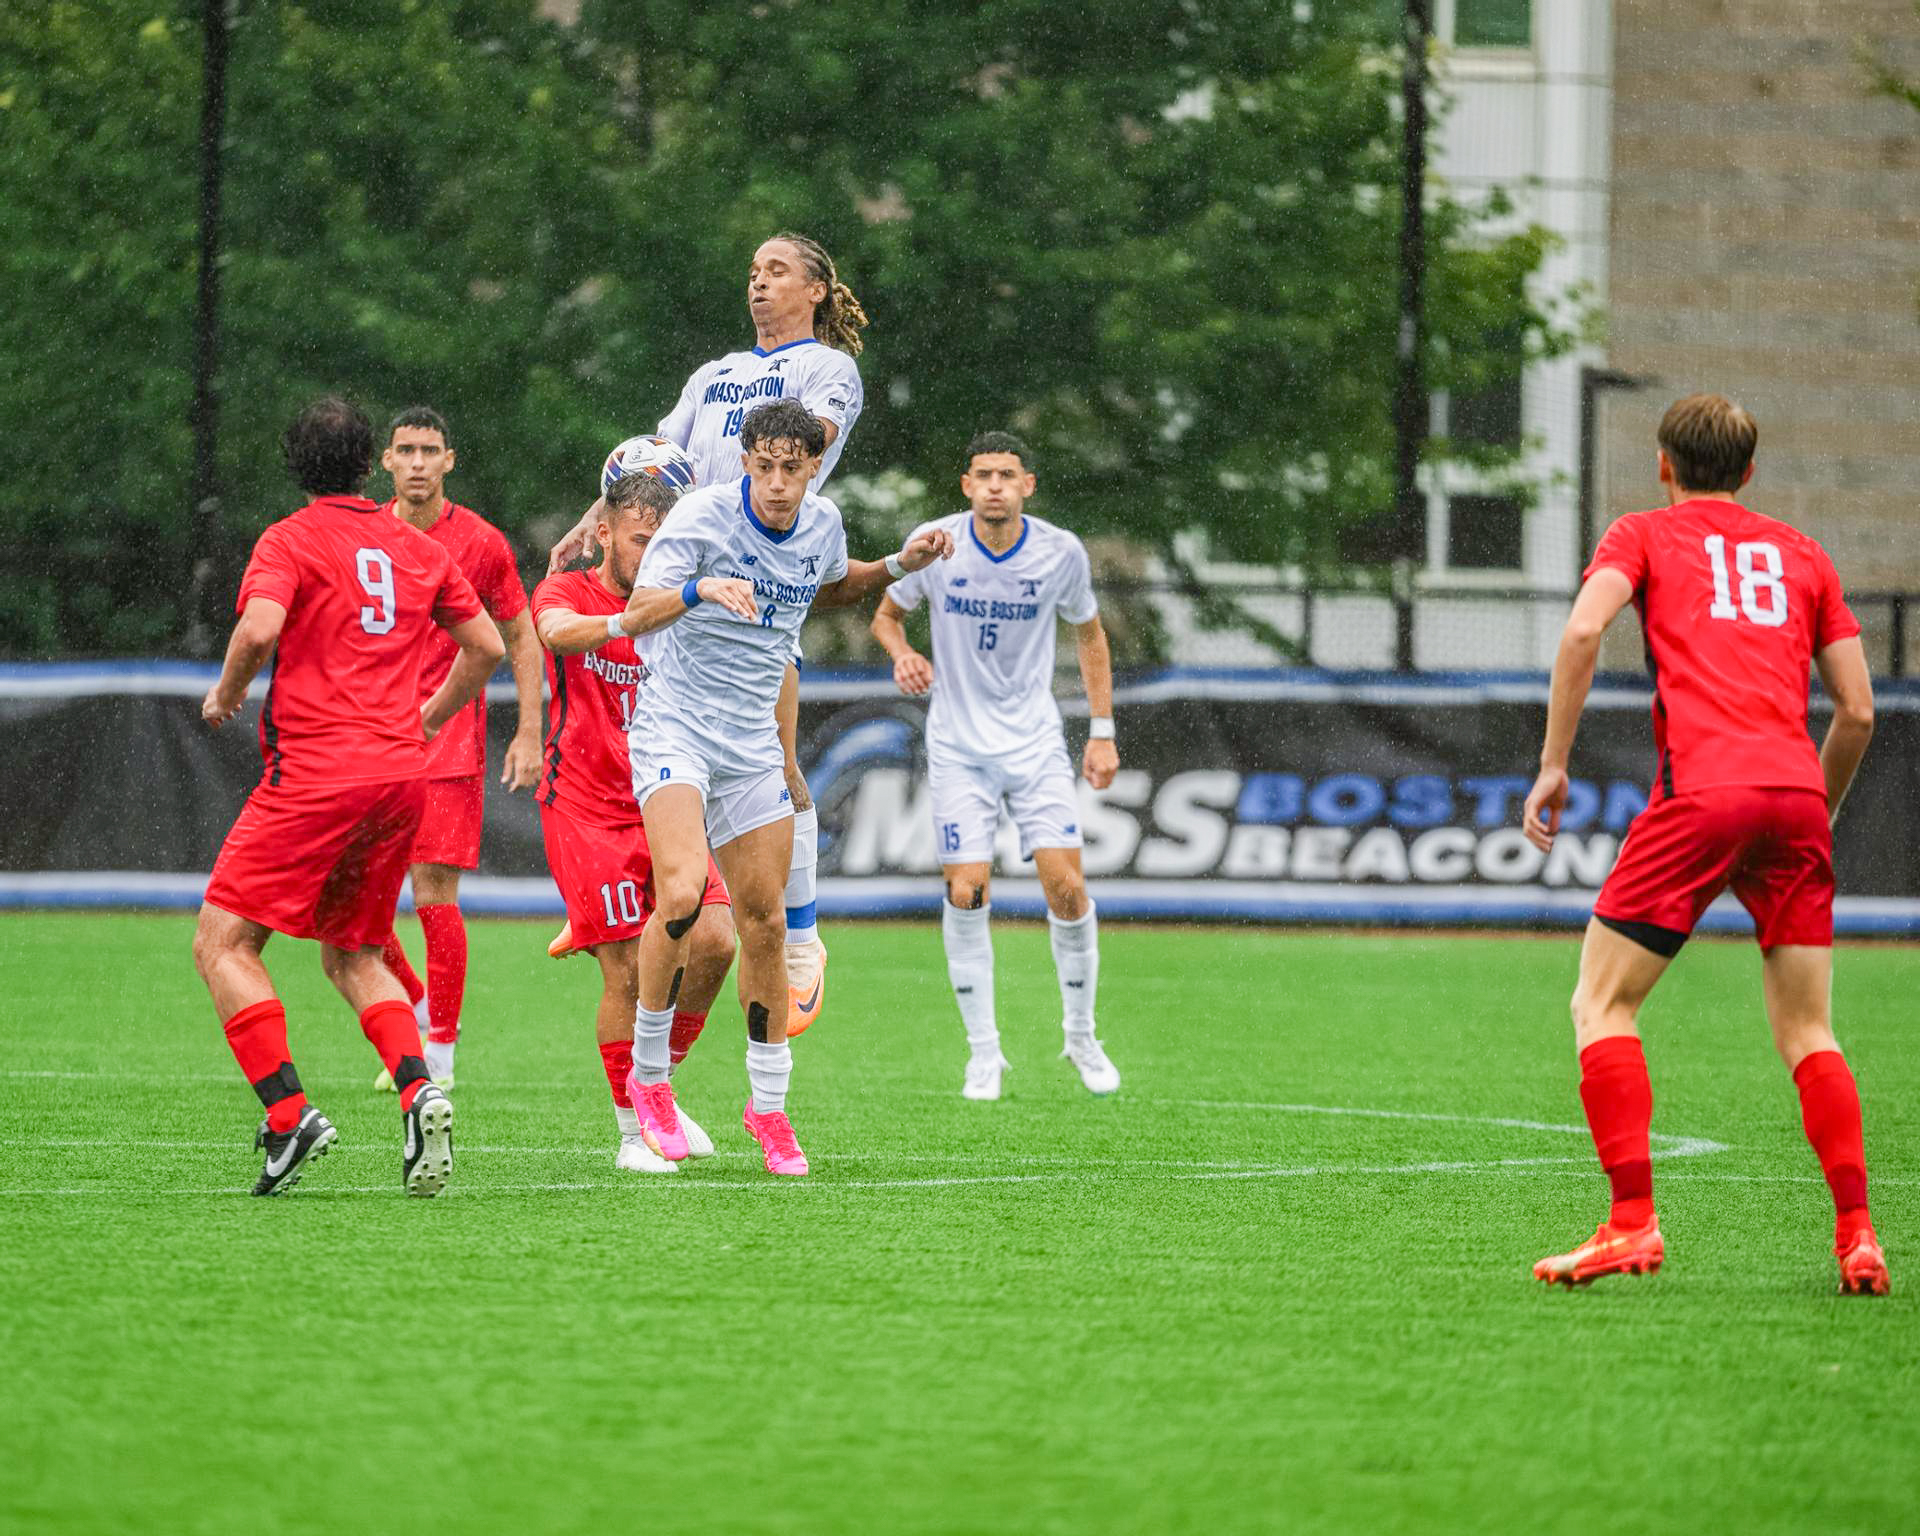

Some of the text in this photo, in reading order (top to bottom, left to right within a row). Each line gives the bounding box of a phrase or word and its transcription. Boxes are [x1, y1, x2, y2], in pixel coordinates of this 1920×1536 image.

[722, 407, 744, 437] 19
[355, 547, 396, 635] 9
[1704, 534, 1789, 628] 18
[762, 604, 777, 628] 8
[990, 600, 1039, 620] BOSTON
[978, 623, 999, 651] 15
[841, 767, 1242, 877] MSS
[943, 822, 961, 851] 15
[600, 879, 641, 928] 10
